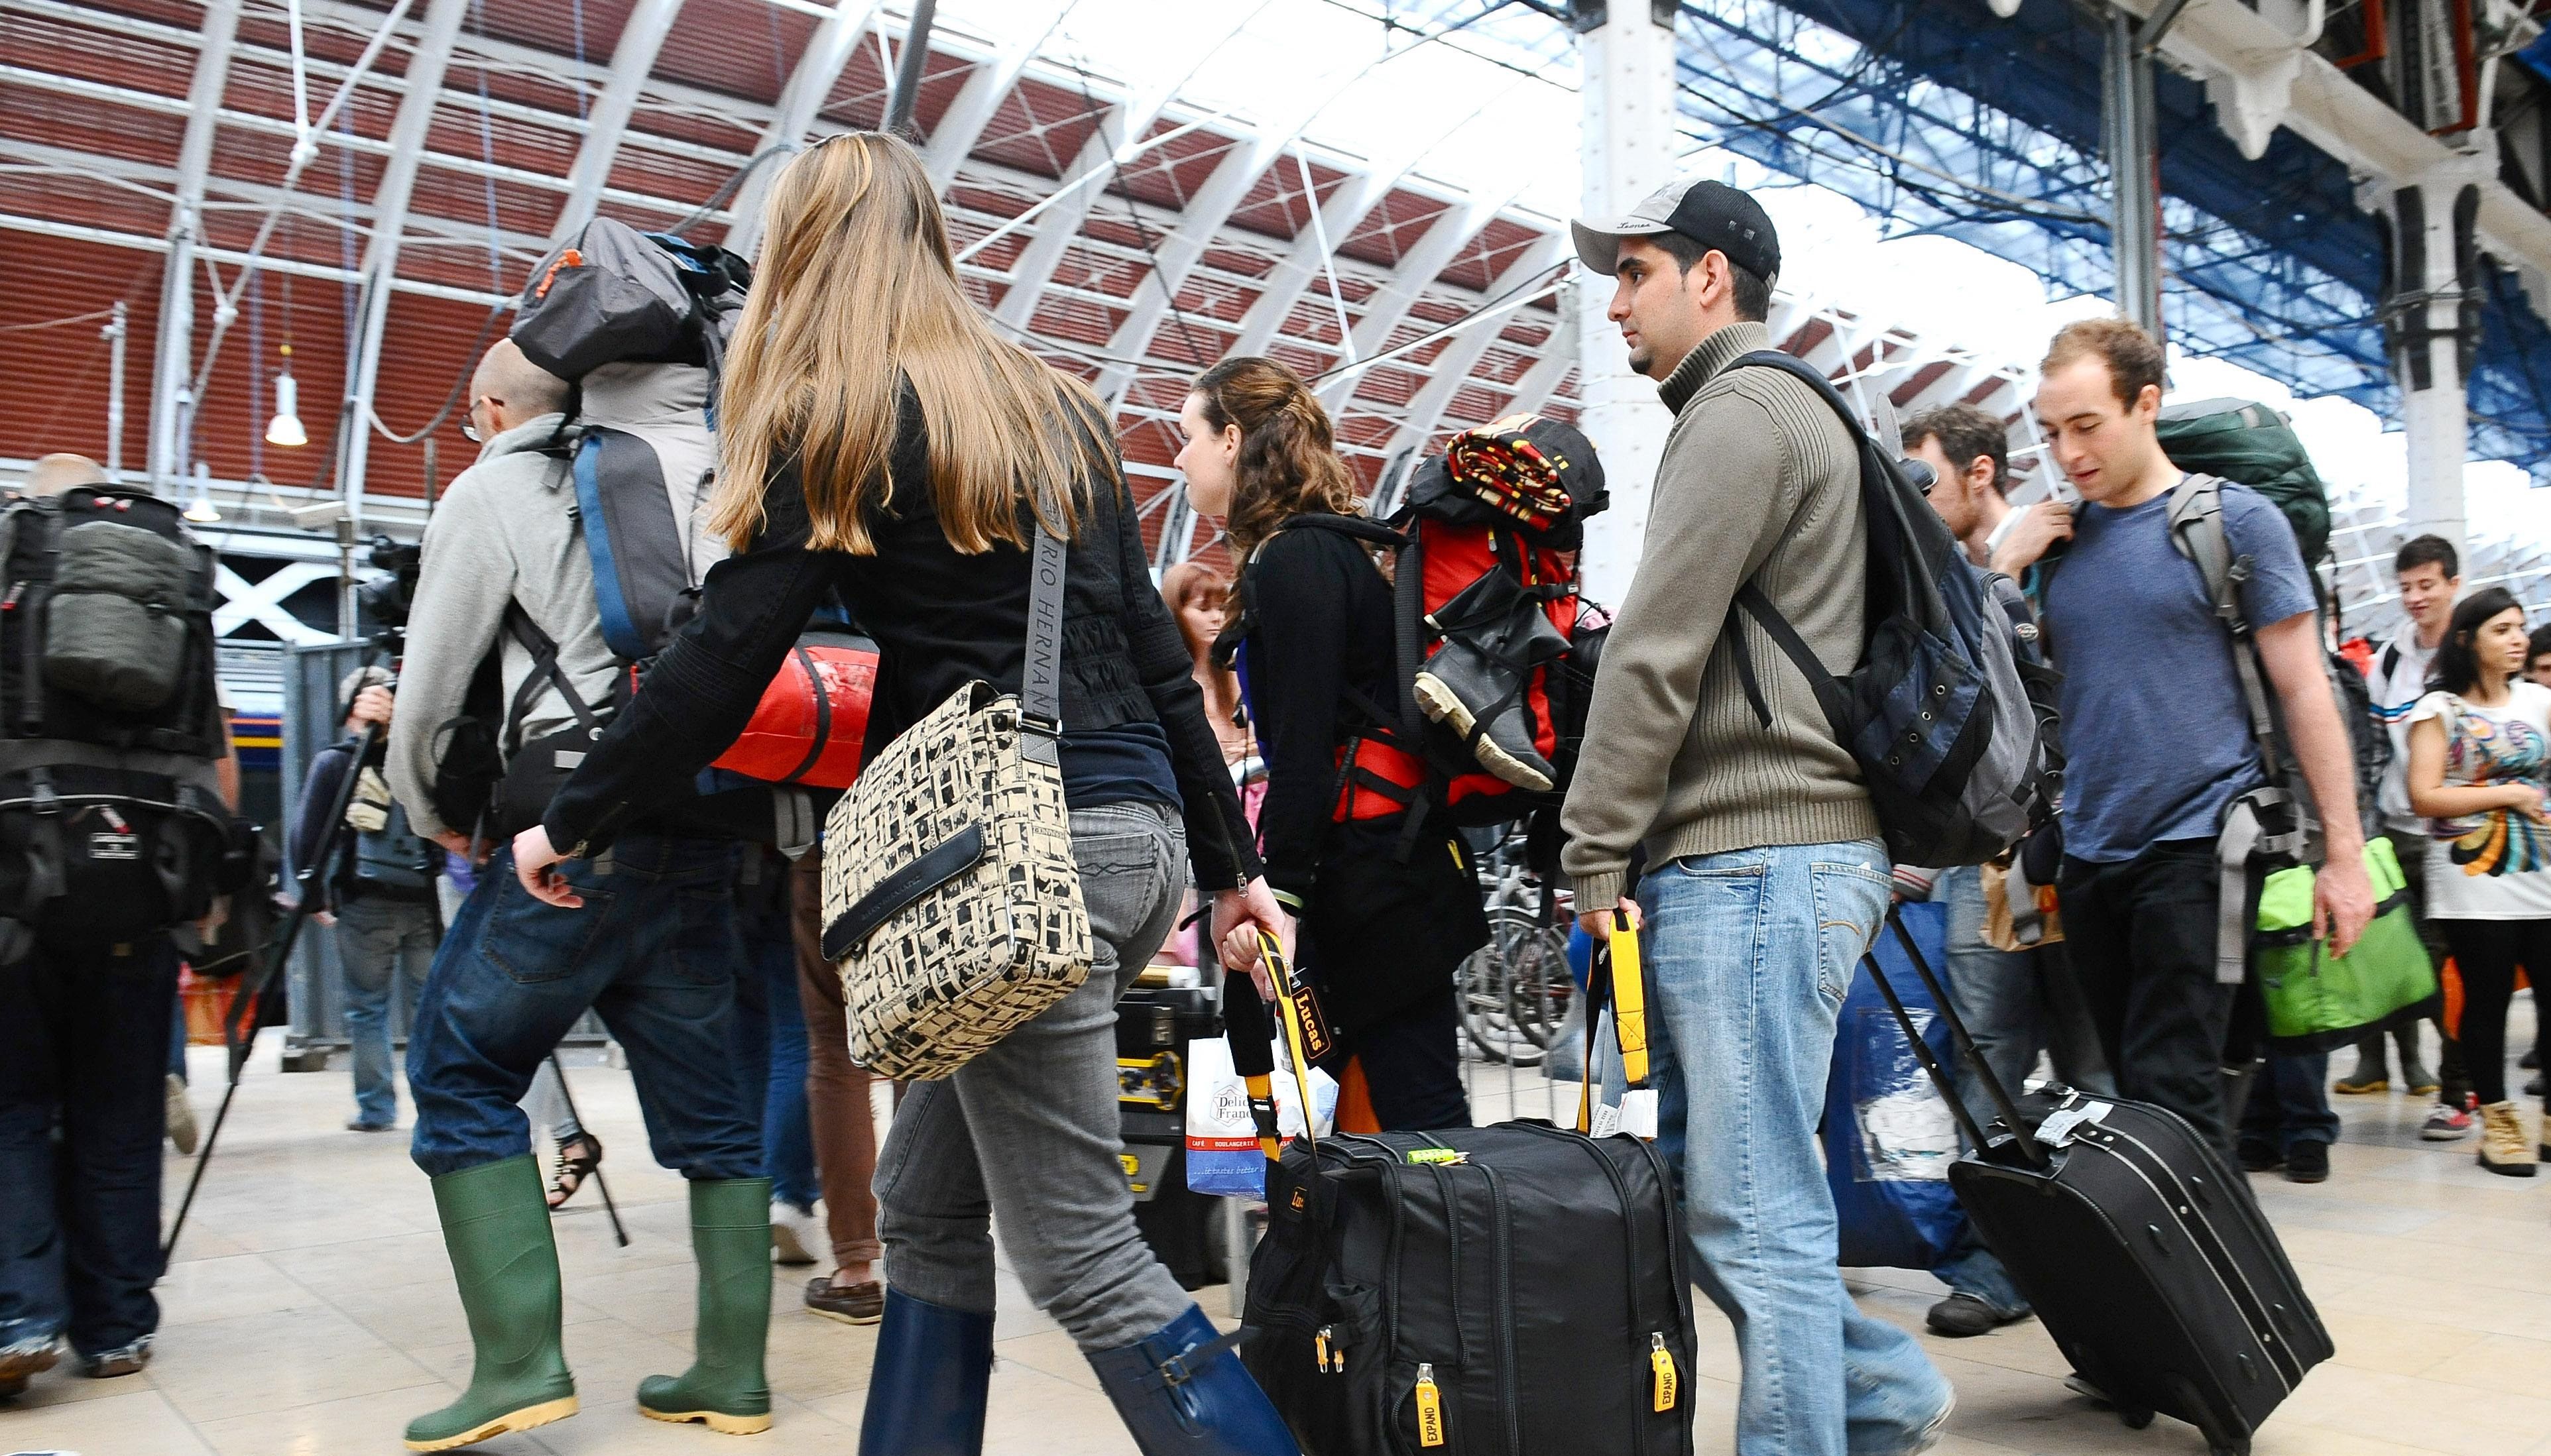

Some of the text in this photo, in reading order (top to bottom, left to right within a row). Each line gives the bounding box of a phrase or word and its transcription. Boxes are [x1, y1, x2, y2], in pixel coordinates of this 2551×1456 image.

[1043, 895, 1064, 905] MARIO
[1296, 993, 1322, 1051] Lucas
[1662, 1372, 1673, 1405] EXPAND
[1424, 1407, 1438, 1441] EXPAND
